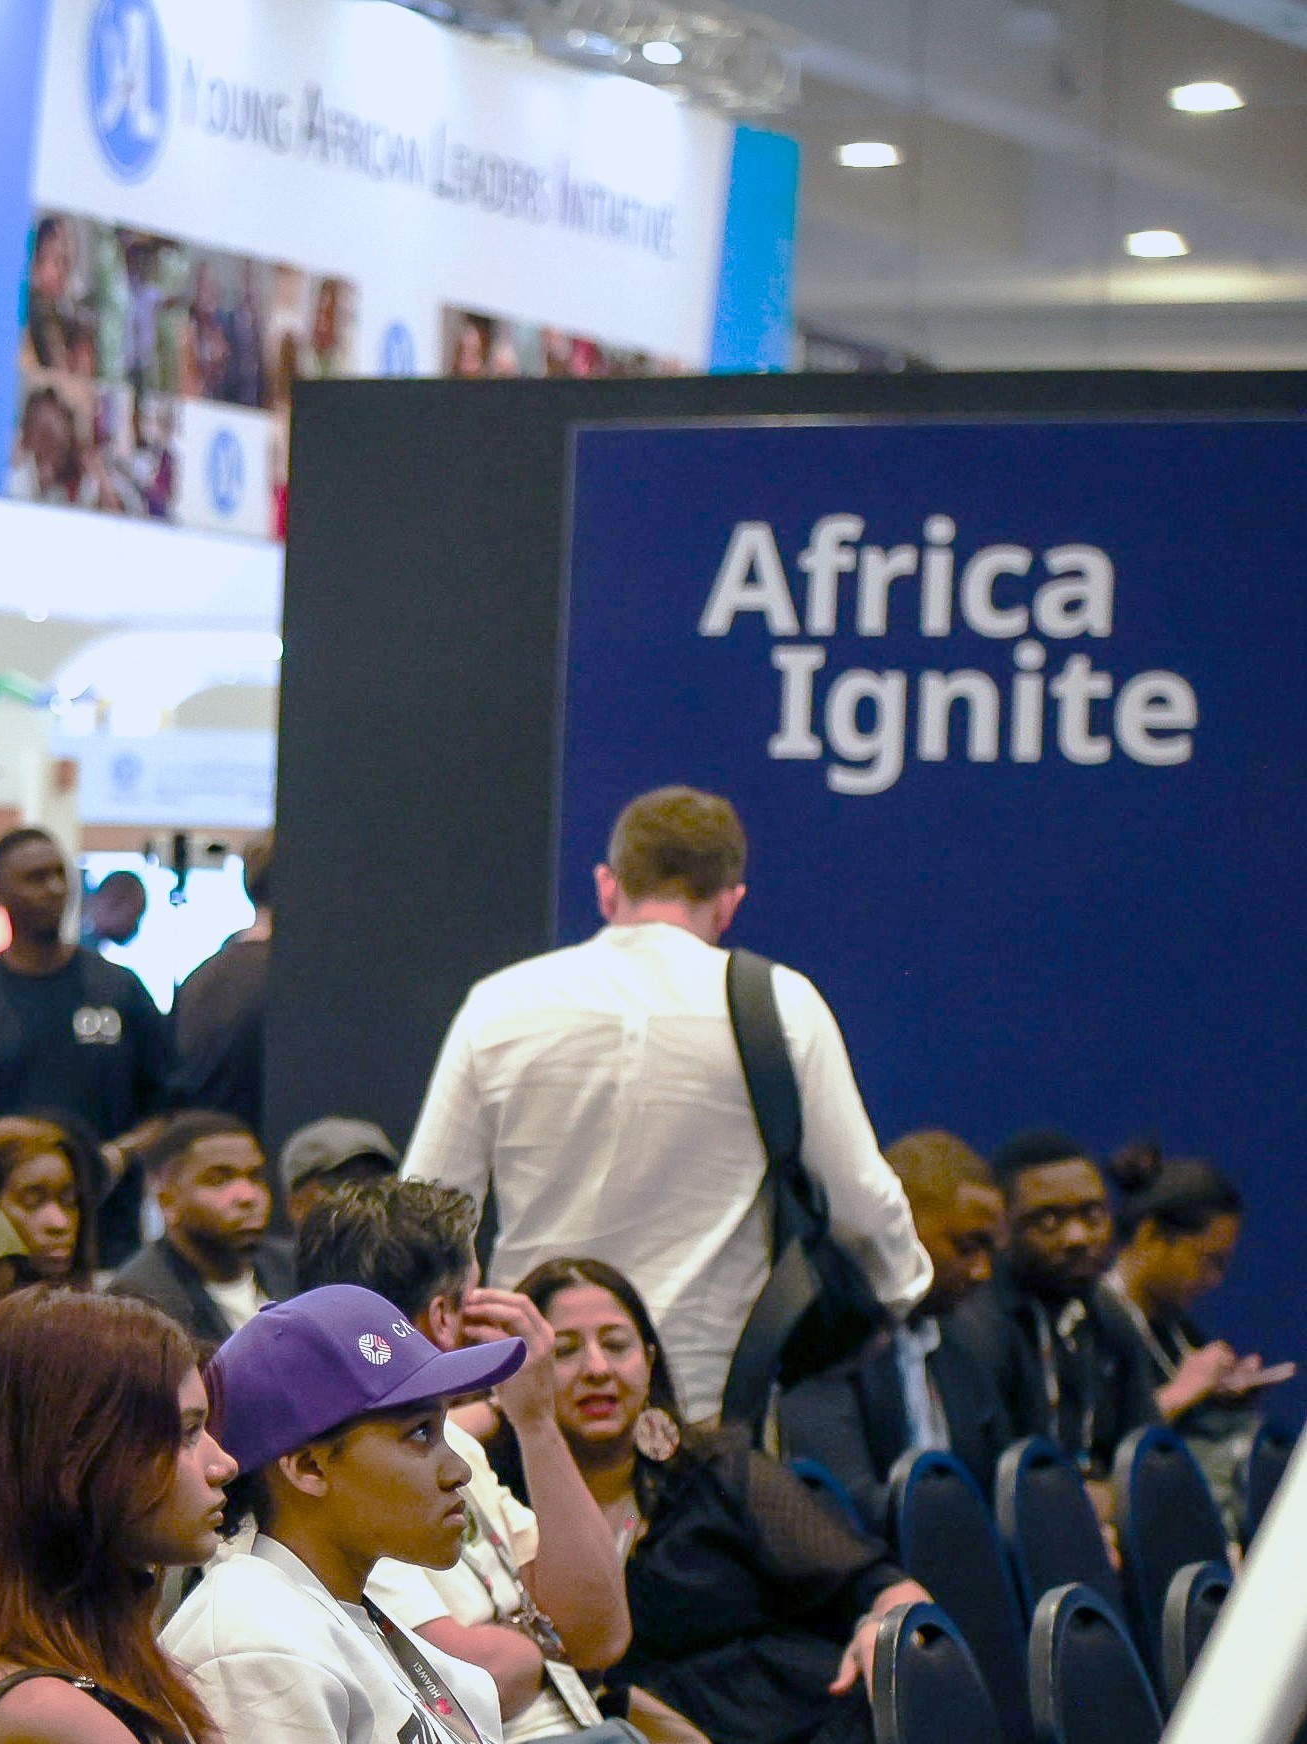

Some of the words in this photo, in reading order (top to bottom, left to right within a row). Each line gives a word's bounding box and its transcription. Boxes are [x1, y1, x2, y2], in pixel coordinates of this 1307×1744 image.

[697, 512, 1116, 640] Africa
[767, 638, 1199, 797] Ignite
[413, 1661, 442, 1700] HUAWEI
